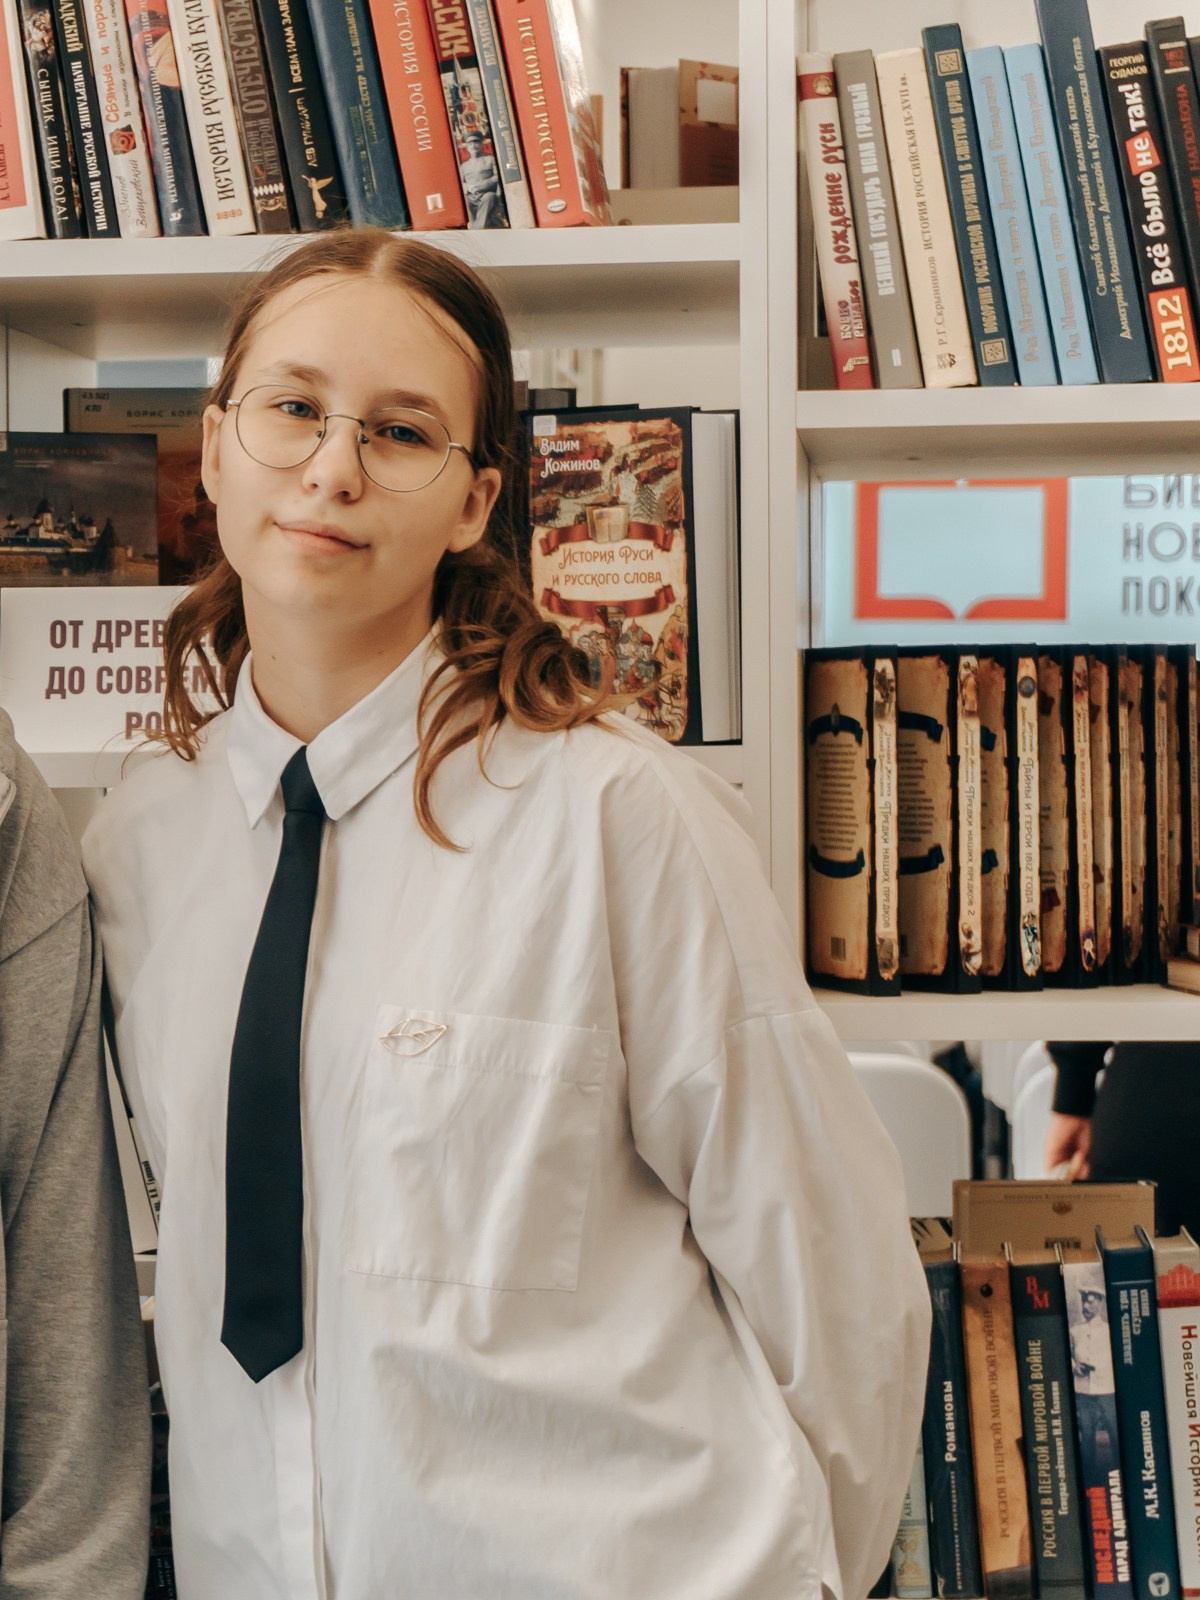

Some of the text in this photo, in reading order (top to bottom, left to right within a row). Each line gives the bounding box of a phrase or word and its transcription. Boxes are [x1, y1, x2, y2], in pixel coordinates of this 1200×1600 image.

[100, 45, 109, 55] и
[284, 28, 296, 52] НАМ
[474, 5, 497, 65] ВЕЛИКИЕ
[1109, 53, 1145, 68] ГЕОРГИЙ
[289, 53, 302, 82] ВСЕМ
[393, 0, 431, 150] ИСТОРИЯ РОССИИ
[1110, 65, 1148, 79] СУДАНОВ
[189, 41, 234, 200] ИСТОРИЯ РУССКОЙ
[518, 18, 559, 188] ИСТОРИЯ РОССИИ
[899, 88, 913, 126] IX-XVII
[945, 80, 963, 114] ВРЕМЯ
[1078, 72, 1098, 148] Куликовская
[37, 68, 67, 220] СЫЩИК, ИЩИ ВОРА!
[71, 61, 107, 230] НАЧЕРТАНИЕ РУССКОЙ ИСТОРИИ
[306, 146, 317, 167] ЛЕВ
[905, 129, 924, 197] РОССИЙСКАЯ
[951, 116, 970, 160] СМУТНОЕ
[161, 147, 177, 203] МЕЦЕНАТЫ
[848, 83, 894, 294] ВЕЛИКИЙ ГОСУДАРЬ ГРОЗНЫЙ
[958, 163, 972, 171] В
[1065, 85, 1107, 295] Святой благоверный великий князь
[1091, 161, 1109, 212] Донской
[1118, 83, 1174, 284] Всё было не так!
[0, 192, 10, 200] А.
[960, 173, 980, 221] ДЕРЖАВЫ
[917, 200, 932, 249] ИСТОРИЯ
[1102, 215, 1120, 282] Иоаннович
[978, 285, 997, 333] ПОБОРНИК
[1112, 284, 1131, 339] Дмитрий
[1157, 296, 1190, 367] 1812
[126, 410, 164, 418] БОРИС
[1122, 576, 1200, 616] ПОК
[50, 620, 83, 648] ОТ
[45, 666, 85, 699] ДО
[1024, 851, 1032, 872] 1812
[985, 1354, 1000, 1418] МИРОВОЙ
[1181, 1325, 1197, 1417] Новейшая
[943, 1381, 956, 1461] Романовы
[989, 1421, 1004, 1472] ПЕРВОЙ
[1026, 1340, 1056, 1557] РОССИЯ В ПЕРВОЙ МИРОВОЙ ВОЙНЕ
[1140, 1410, 1159, 1518] М.К. Касвинов
[1088, 1487, 1113, 1582] ПОСЛЕДНИЙ
[1108, 1470, 1129, 1582] ПАРАД АДМИРАЛА
